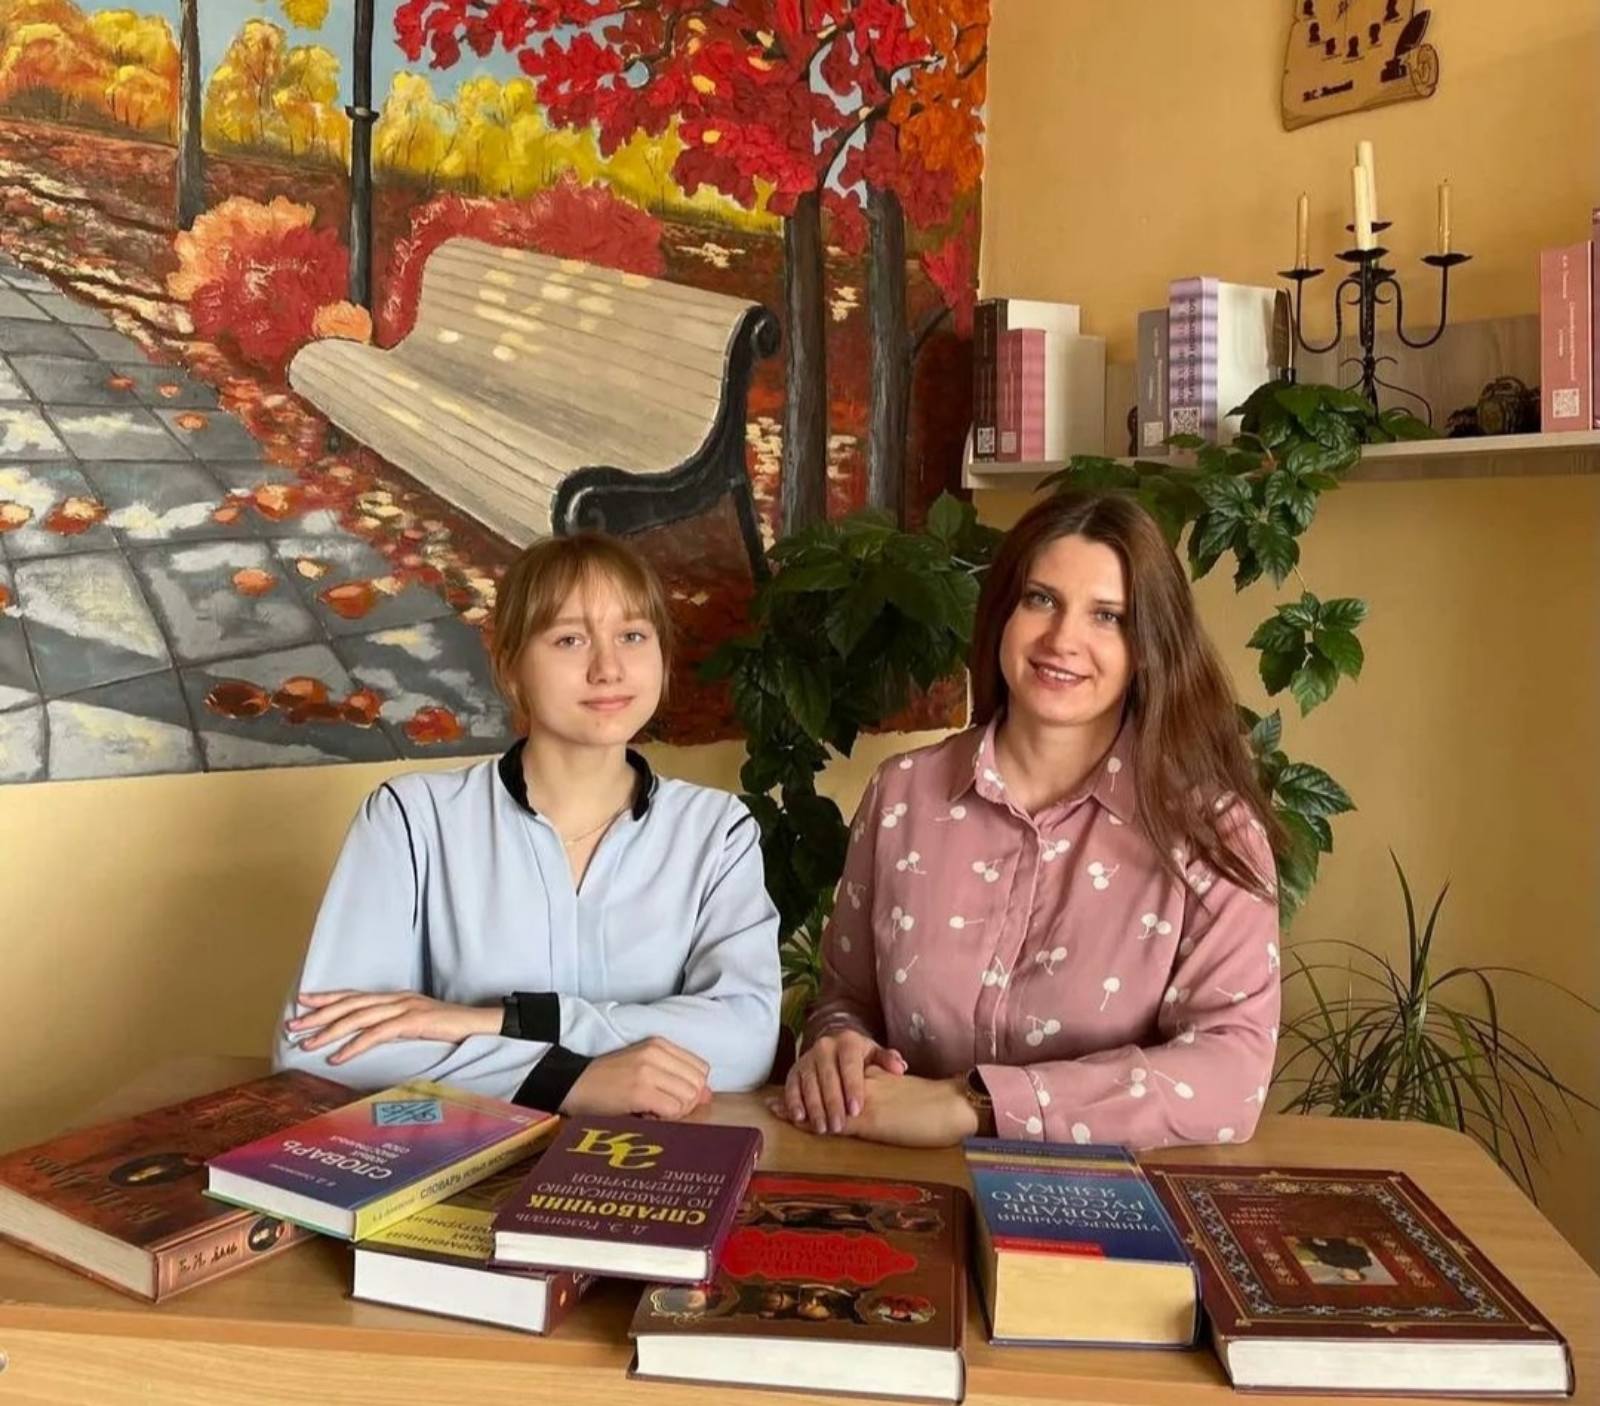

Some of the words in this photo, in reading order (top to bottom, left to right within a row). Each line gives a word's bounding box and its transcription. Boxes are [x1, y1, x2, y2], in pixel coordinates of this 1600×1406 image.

[282, 1139, 393, 1180] СЛОВАРЬ
[571, 1172, 702, 1195] ЛИТЕРАТУРНОЙ
[663, 1169, 727, 1185] ПРАВКЕ
[537, 1182, 681, 1207] ПРАВОПИСАНИЮ
[991, 1190, 1145, 1211] РУССКОГО
[1016, 1181, 1117, 1199] ЯЗЫКА
[526, 1193, 707, 1226] СПРАВОЧНИК
[686, 1198, 714, 1210] ПО
[1003, 1202, 1143, 1223] СЛОВАРЬ
[515, 1212, 600, 1232] Розенталь
[997, 1213, 1161, 1232] УНИВЕРСАЛЬНЫЙ
